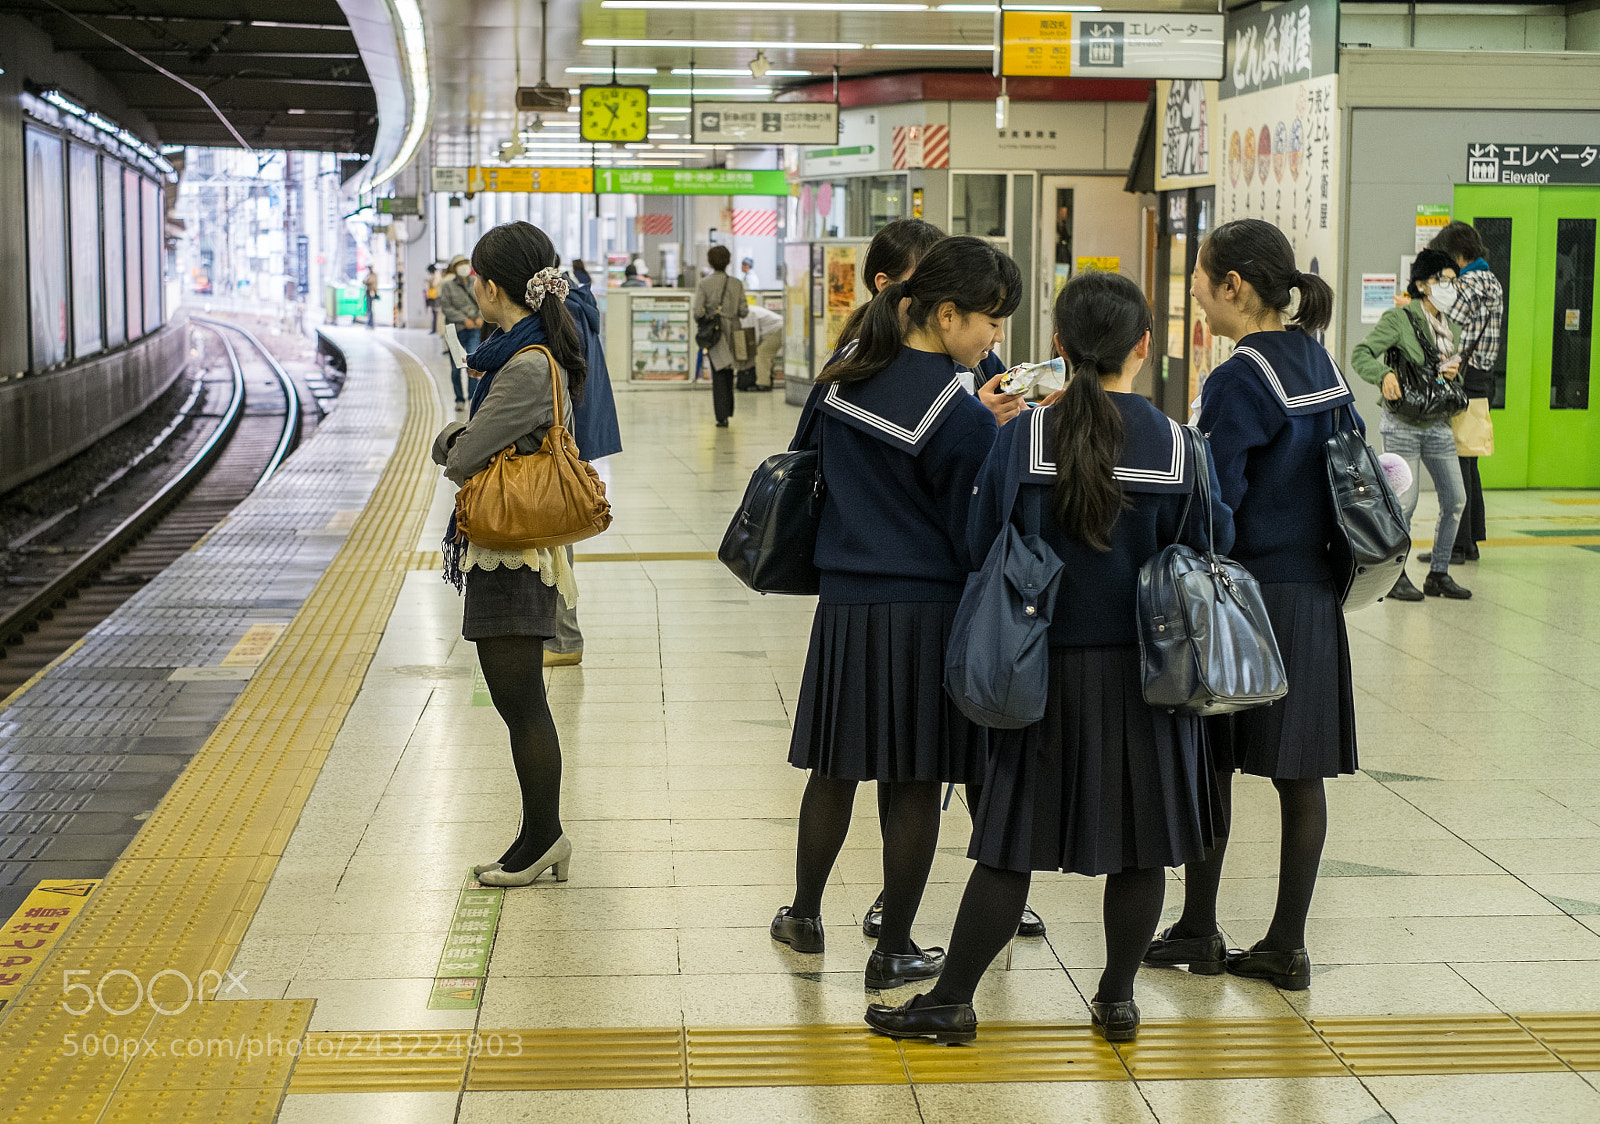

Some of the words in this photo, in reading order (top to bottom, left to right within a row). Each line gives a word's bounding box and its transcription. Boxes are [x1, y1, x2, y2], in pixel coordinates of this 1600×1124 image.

[1129, 22, 1213, 36] エレベーター
[1233, 4, 1312, 90] どん兵衛屋
[1502, 145, 1600, 168] エレベータ
[602, 171, 612, 192] 1
[1502, 170, 1550, 184] Elevator
